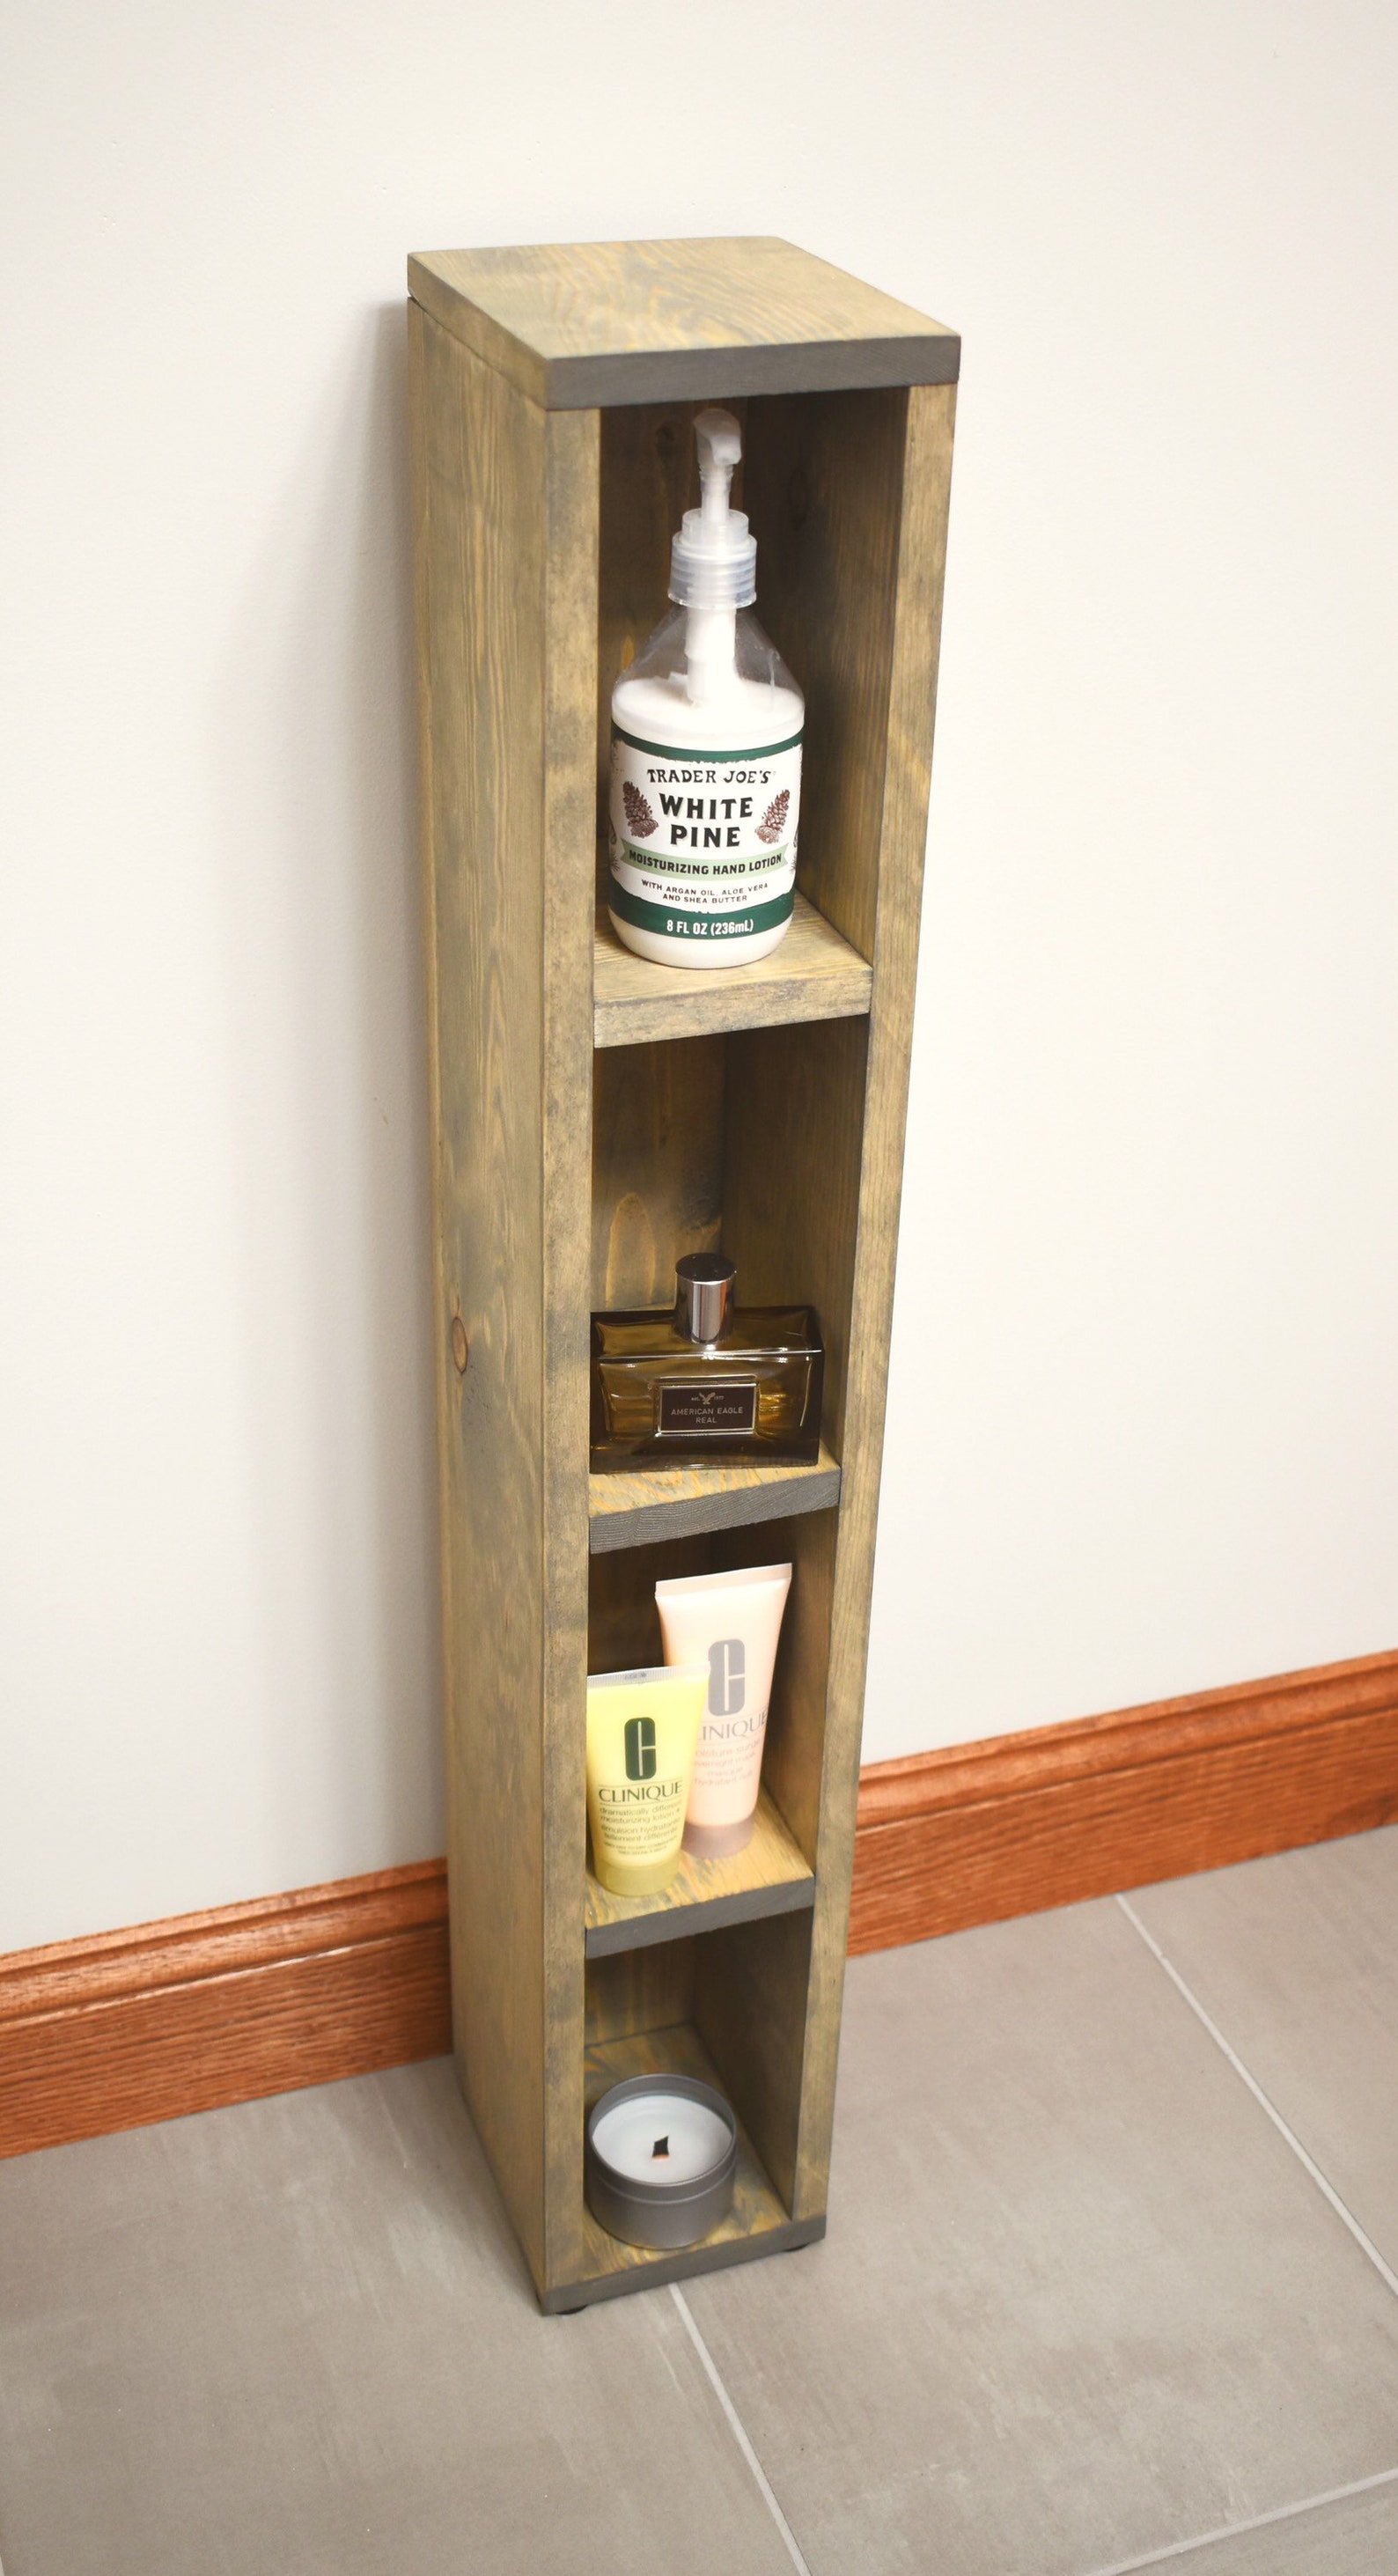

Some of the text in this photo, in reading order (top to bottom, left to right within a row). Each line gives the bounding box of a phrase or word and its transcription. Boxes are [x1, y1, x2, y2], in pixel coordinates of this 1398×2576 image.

[647, 769, 771, 784] TRADER JOE'S
[659, 792, 754, 821] WHITE
[670, 823, 740, 848] PINE
[629, 849, 783, 875] MOISTURIZING HAND LOTION
[641, 879, 663, 891] WITH
[666, 886, 696, 895] ARGAN
[747, 883, 769, 893] VERA
[663, 894, 681, 902] AND
[711, 894, 747, 904] BUTTER
[666, 918, 754, 937] 8 FL OZ (236mL)
[717, 1406, 743, 1415] EAGLE
[697, 1710, 768, 1741] INIQUE
[599, 1781, 683, 1802] CLINIQUE
